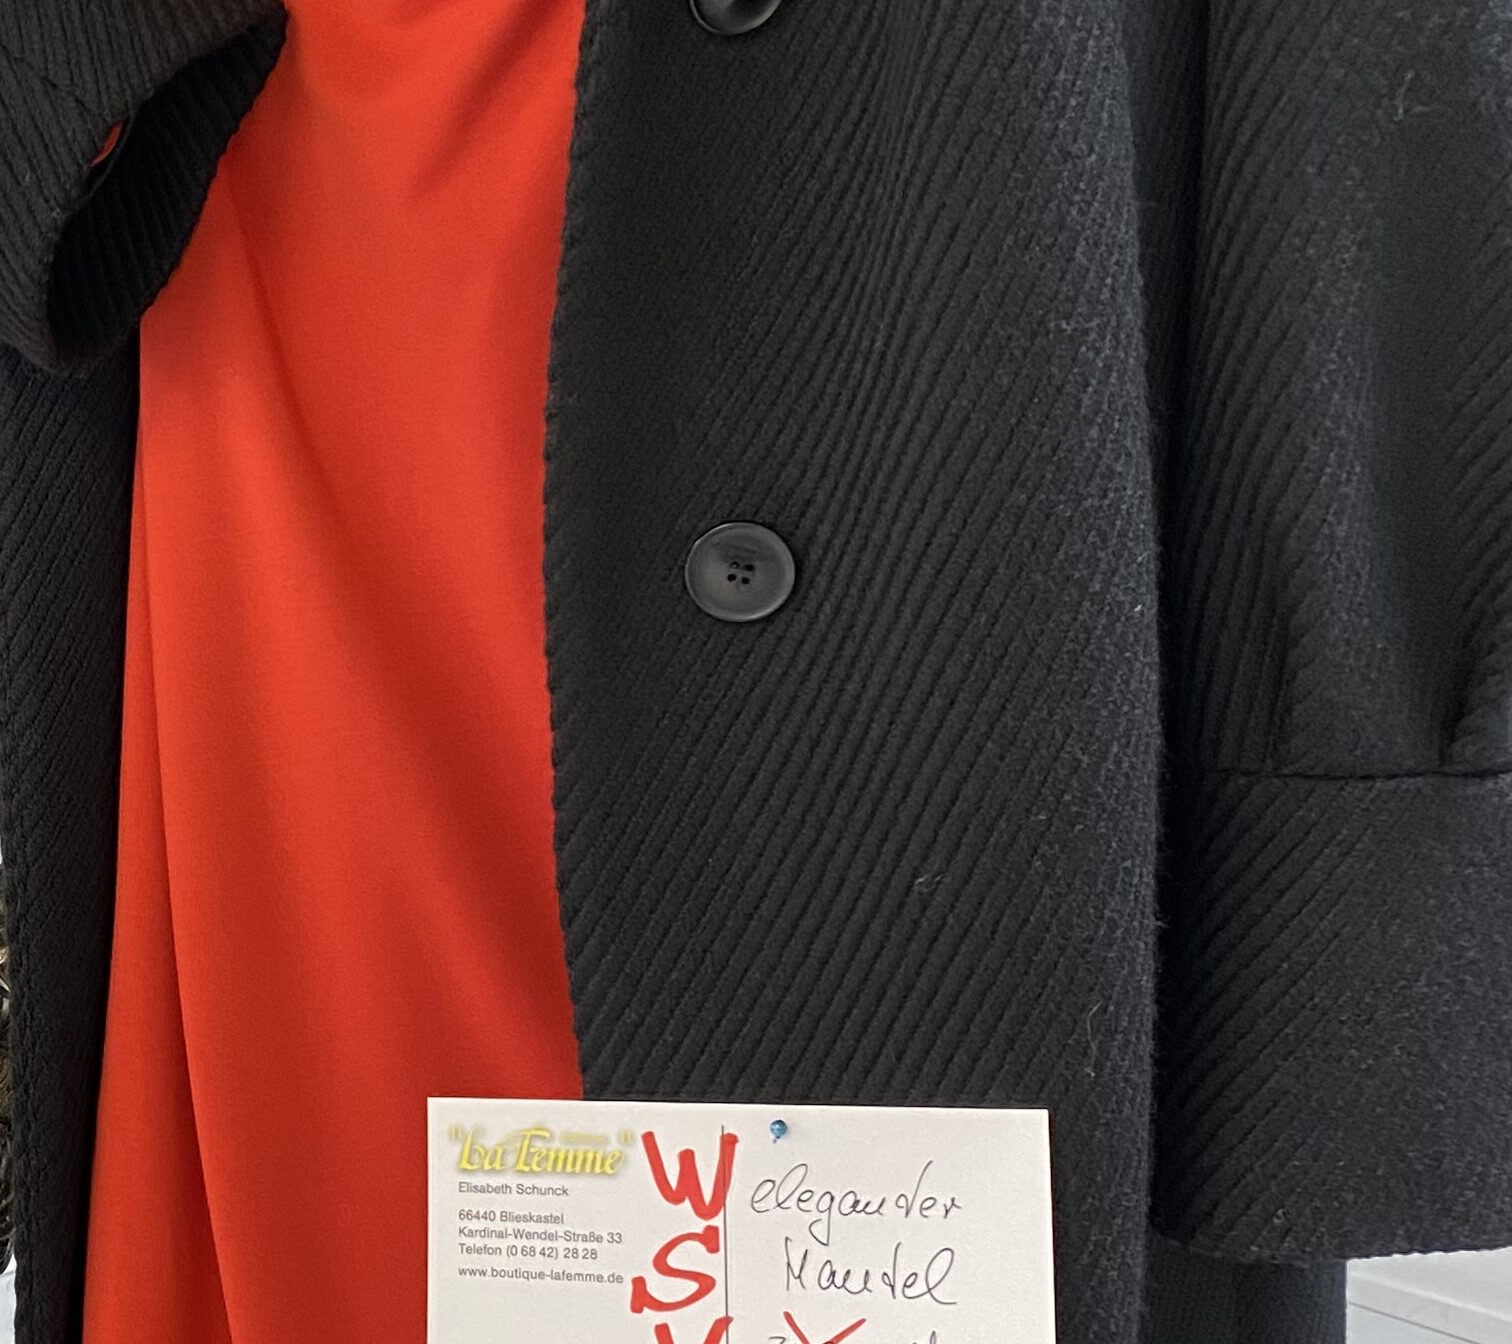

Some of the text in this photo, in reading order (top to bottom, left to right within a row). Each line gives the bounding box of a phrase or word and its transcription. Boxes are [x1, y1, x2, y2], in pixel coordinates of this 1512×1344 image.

[457, 1181, 570, 1197] Elisabeth Schunck
[457, 1208, 565, 1225] 66440 Blieskastel
[457, 1226, 623, 1244] Kardinal-Wendel-Straße 33
[458, 1242, 502, 1256] Telefon
[457, 1266, 625, 1284] www.boutique-lafemme.de
[784, 1235, 958, 1305] Mantel
